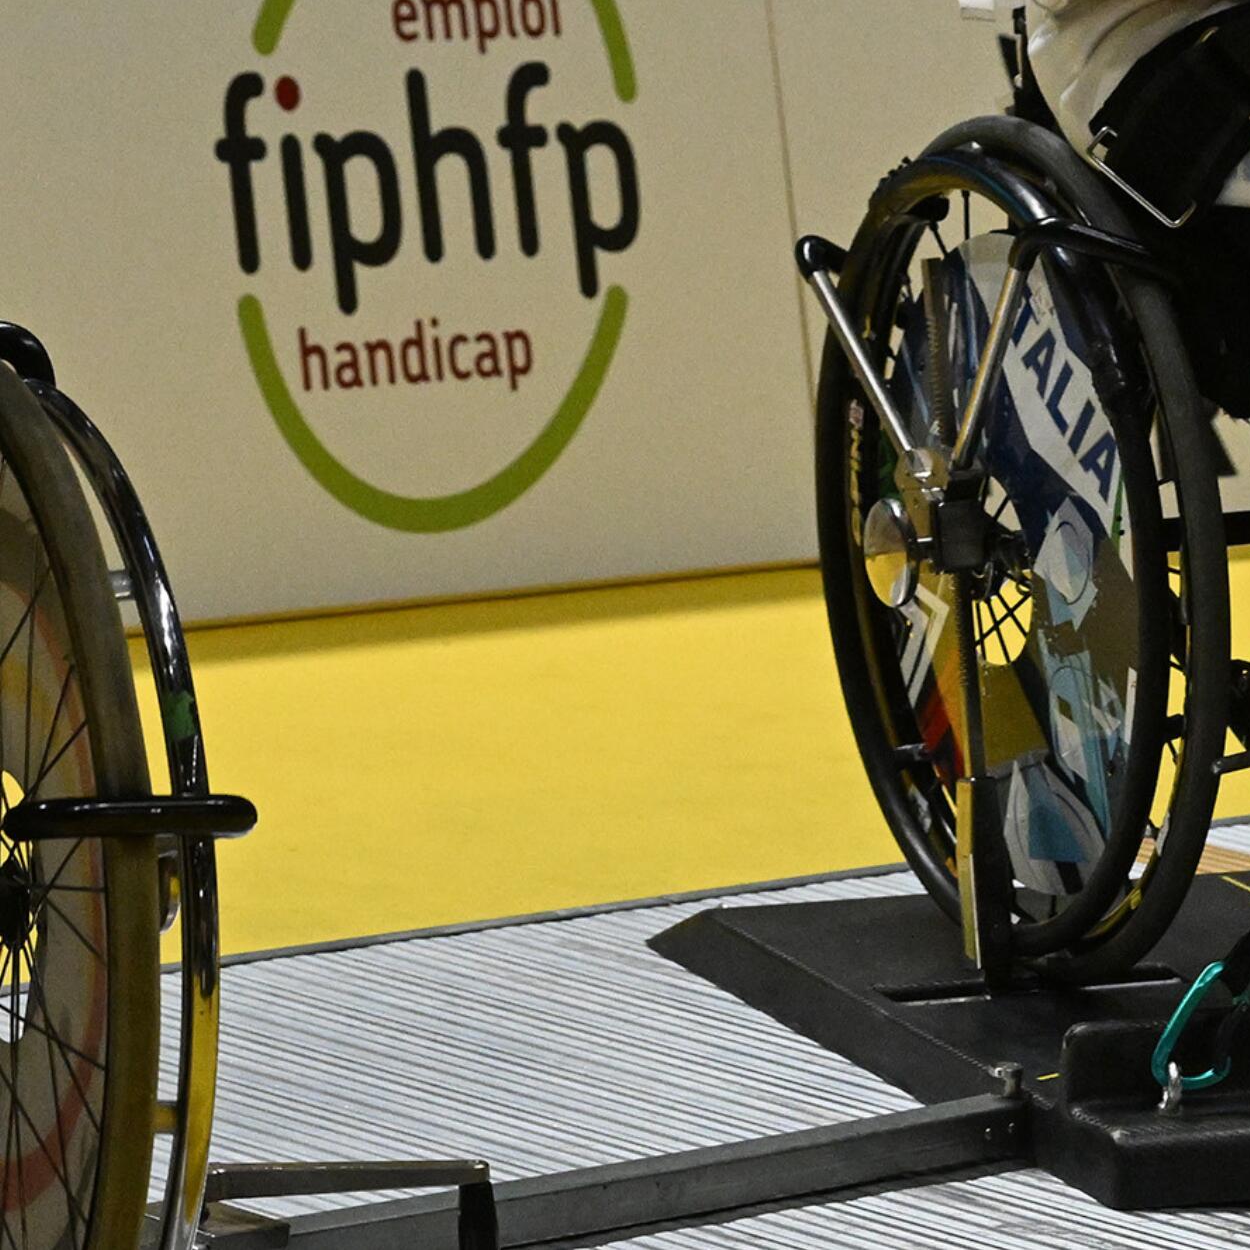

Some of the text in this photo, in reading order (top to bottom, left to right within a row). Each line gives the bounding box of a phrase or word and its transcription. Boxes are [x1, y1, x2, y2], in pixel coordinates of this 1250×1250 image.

[214, 61, 641, 316] fiphfp
[298, 317, 535, 392] handicap
[1011, 282, 1119, 505] TALIA
